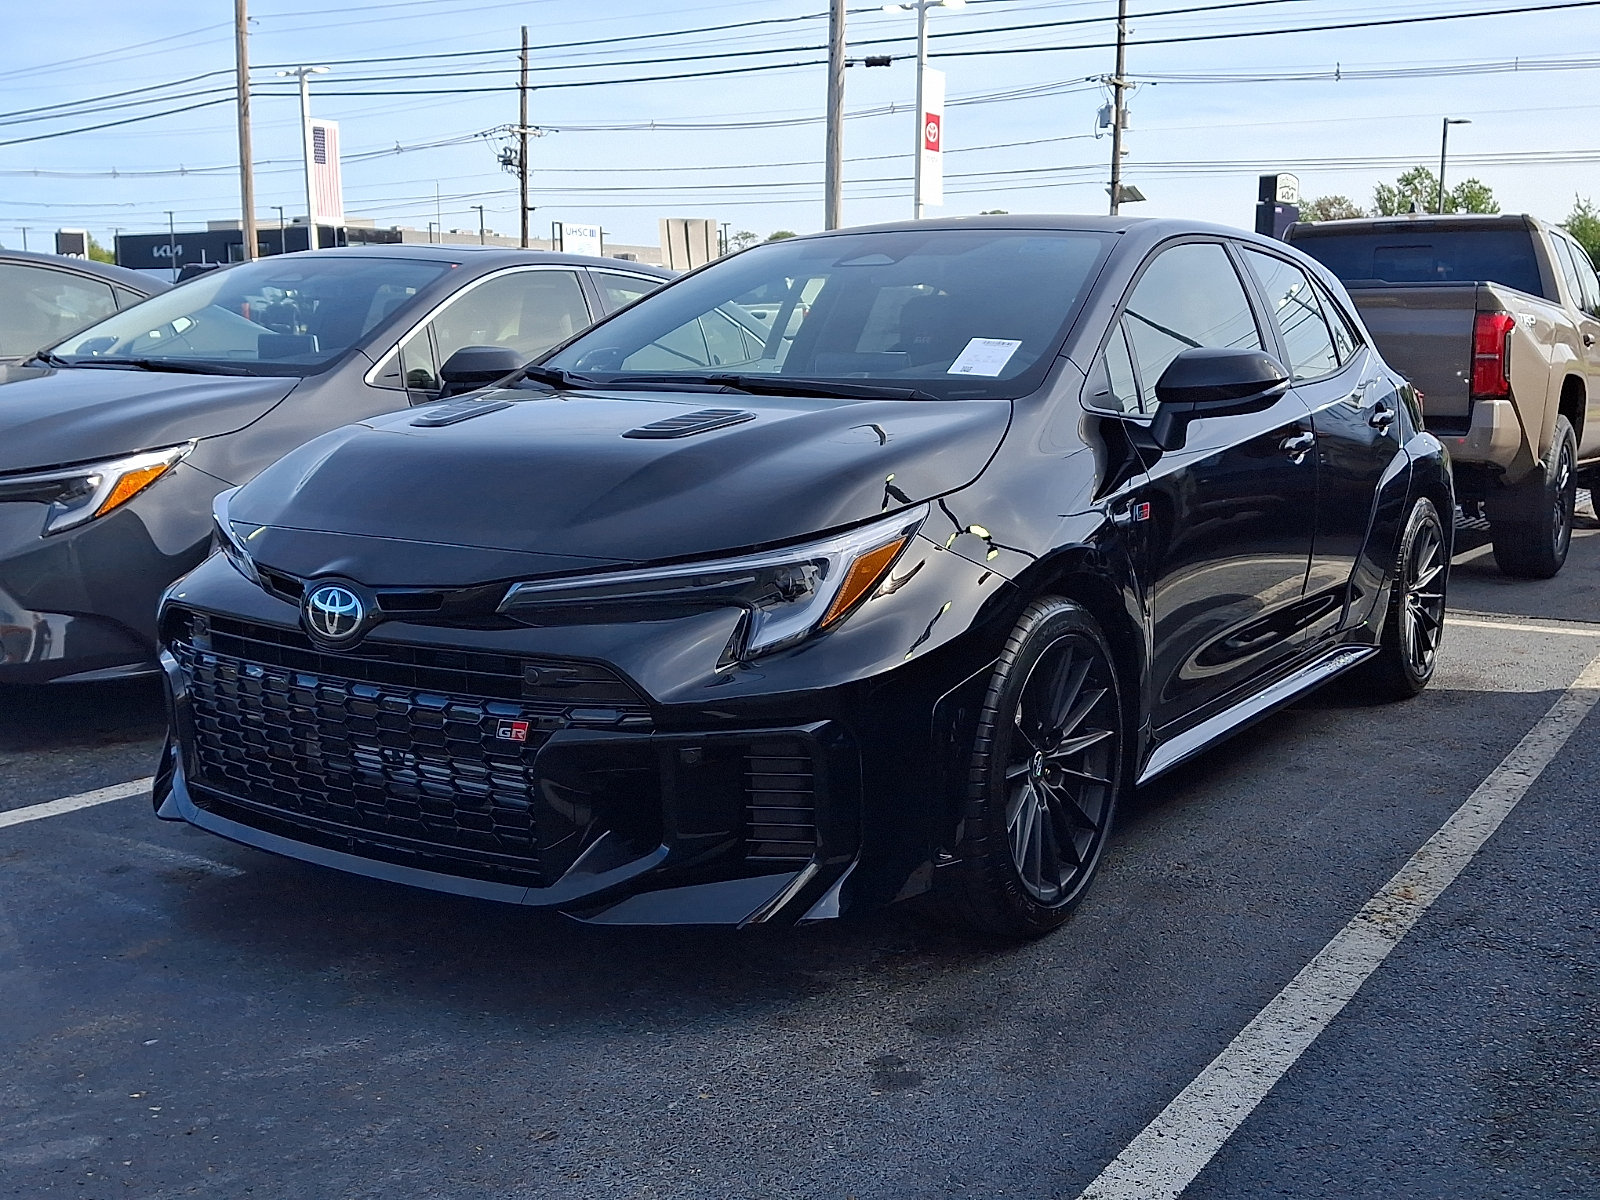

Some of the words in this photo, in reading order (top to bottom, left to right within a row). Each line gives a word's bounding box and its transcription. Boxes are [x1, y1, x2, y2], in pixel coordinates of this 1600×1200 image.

[565, 227, 589, 237] UHSC
[152, 244, 183, 257] KIA
[498, 727, 526, 740] GR
